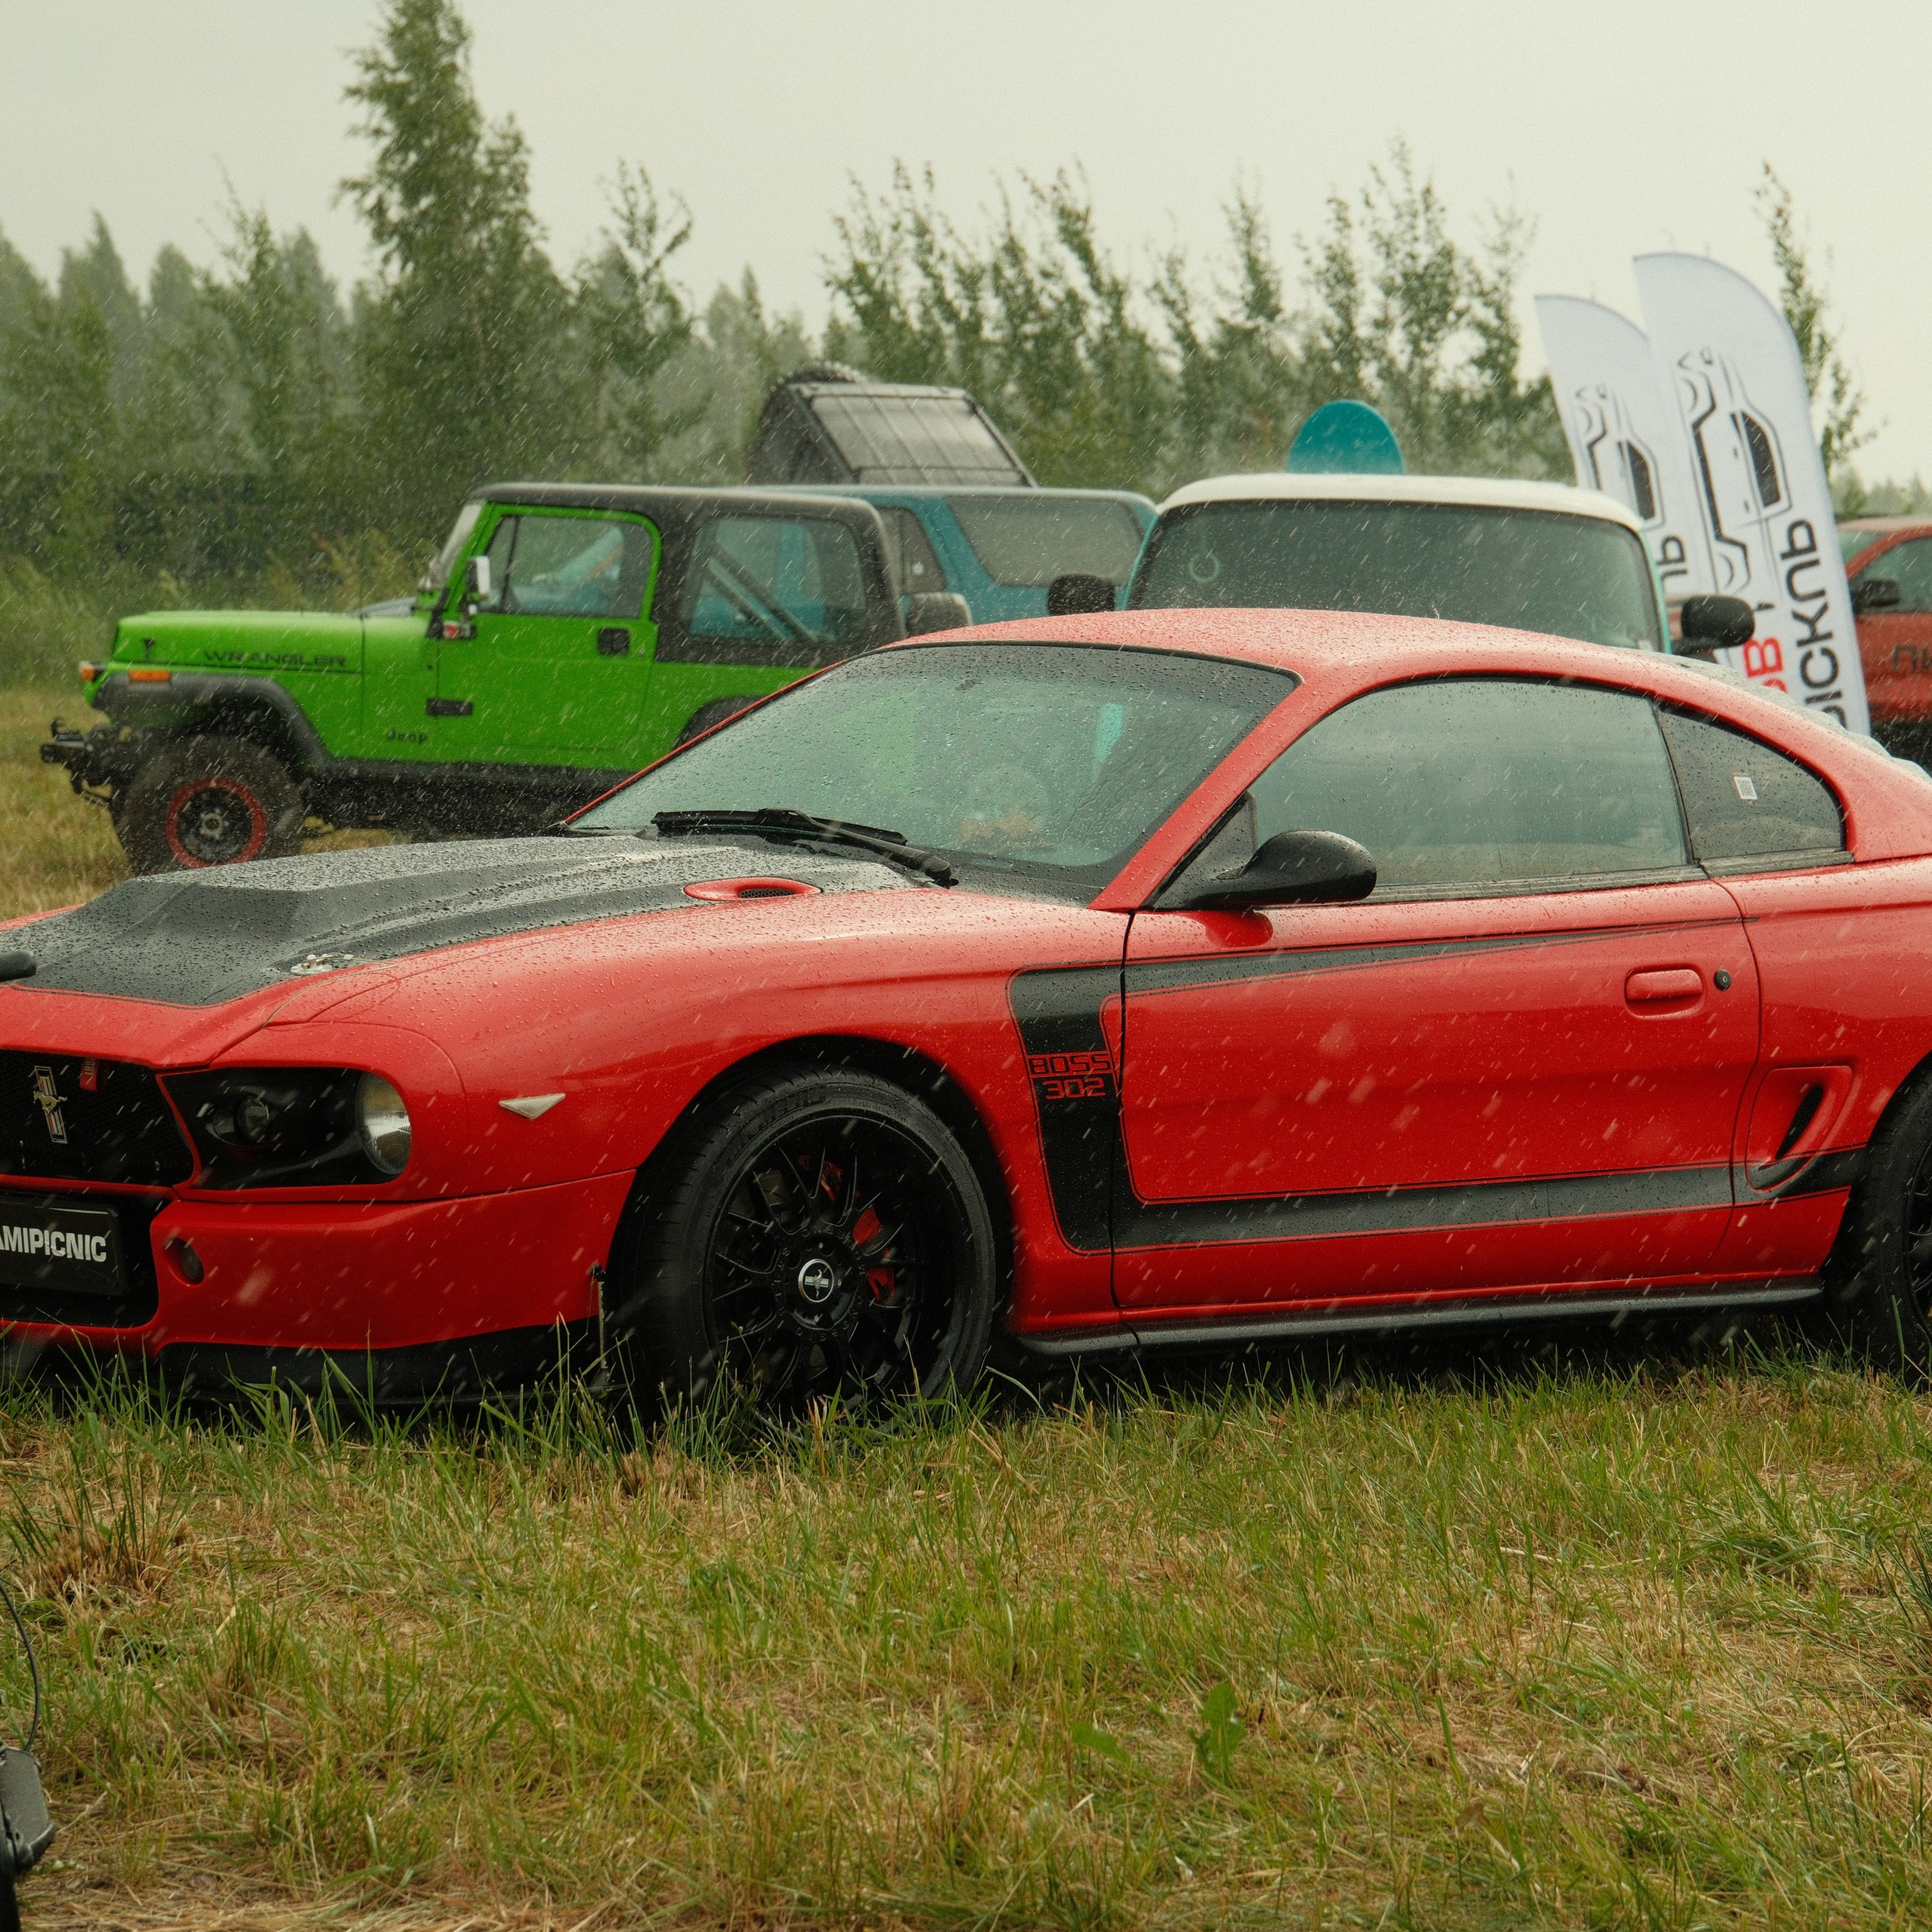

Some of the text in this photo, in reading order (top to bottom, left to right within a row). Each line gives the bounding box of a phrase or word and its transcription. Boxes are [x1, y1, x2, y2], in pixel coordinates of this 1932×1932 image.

[204, 650, 347, 667] WRANGLER
[1028, 1054, 1112, 1075] BOSS
[1042, 1077, 1106, 1100] 302
